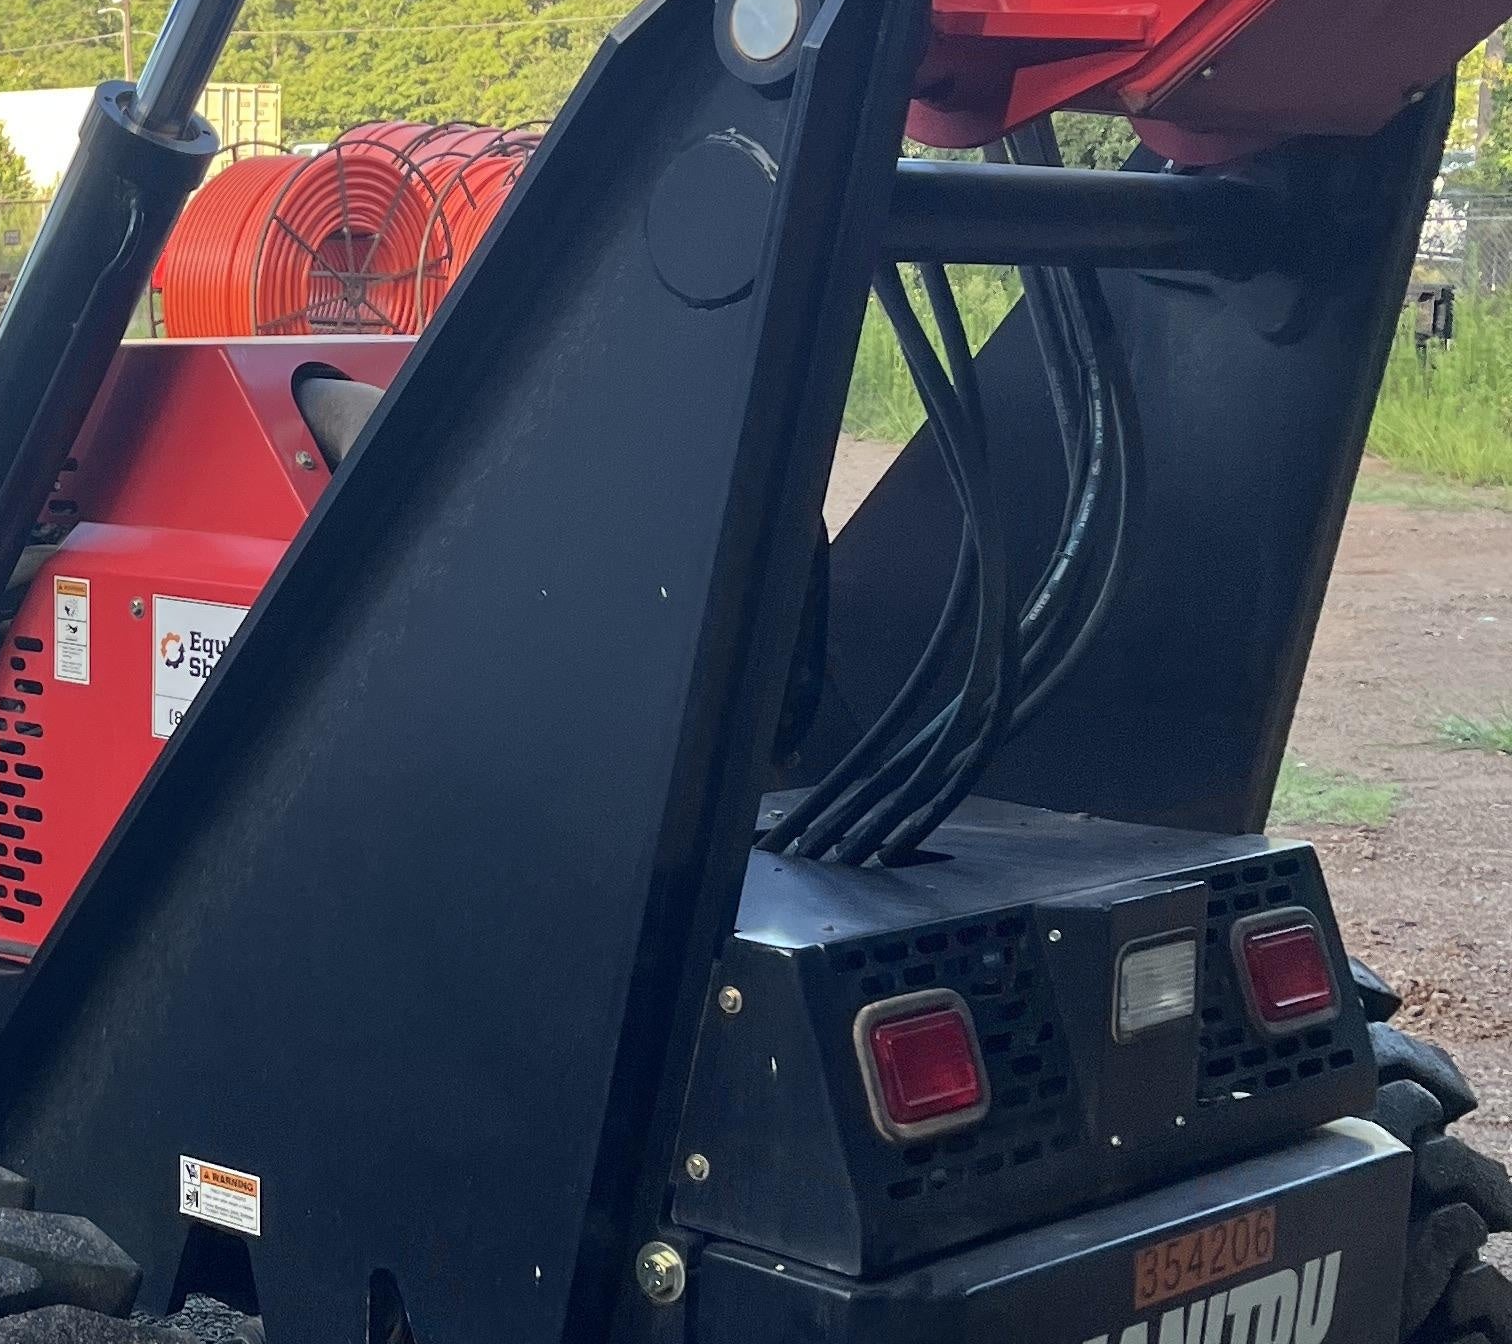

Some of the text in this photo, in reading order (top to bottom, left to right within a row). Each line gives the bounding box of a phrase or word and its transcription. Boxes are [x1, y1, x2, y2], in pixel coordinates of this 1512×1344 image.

[189, 630, 234, 659] Equ
[189, 656, 214, 679] Sh
[169, 708, 184, 726] (8
[212, 1172, 254, 1193] WARNING
[1142, 1211, 1271, 1301] 354206
